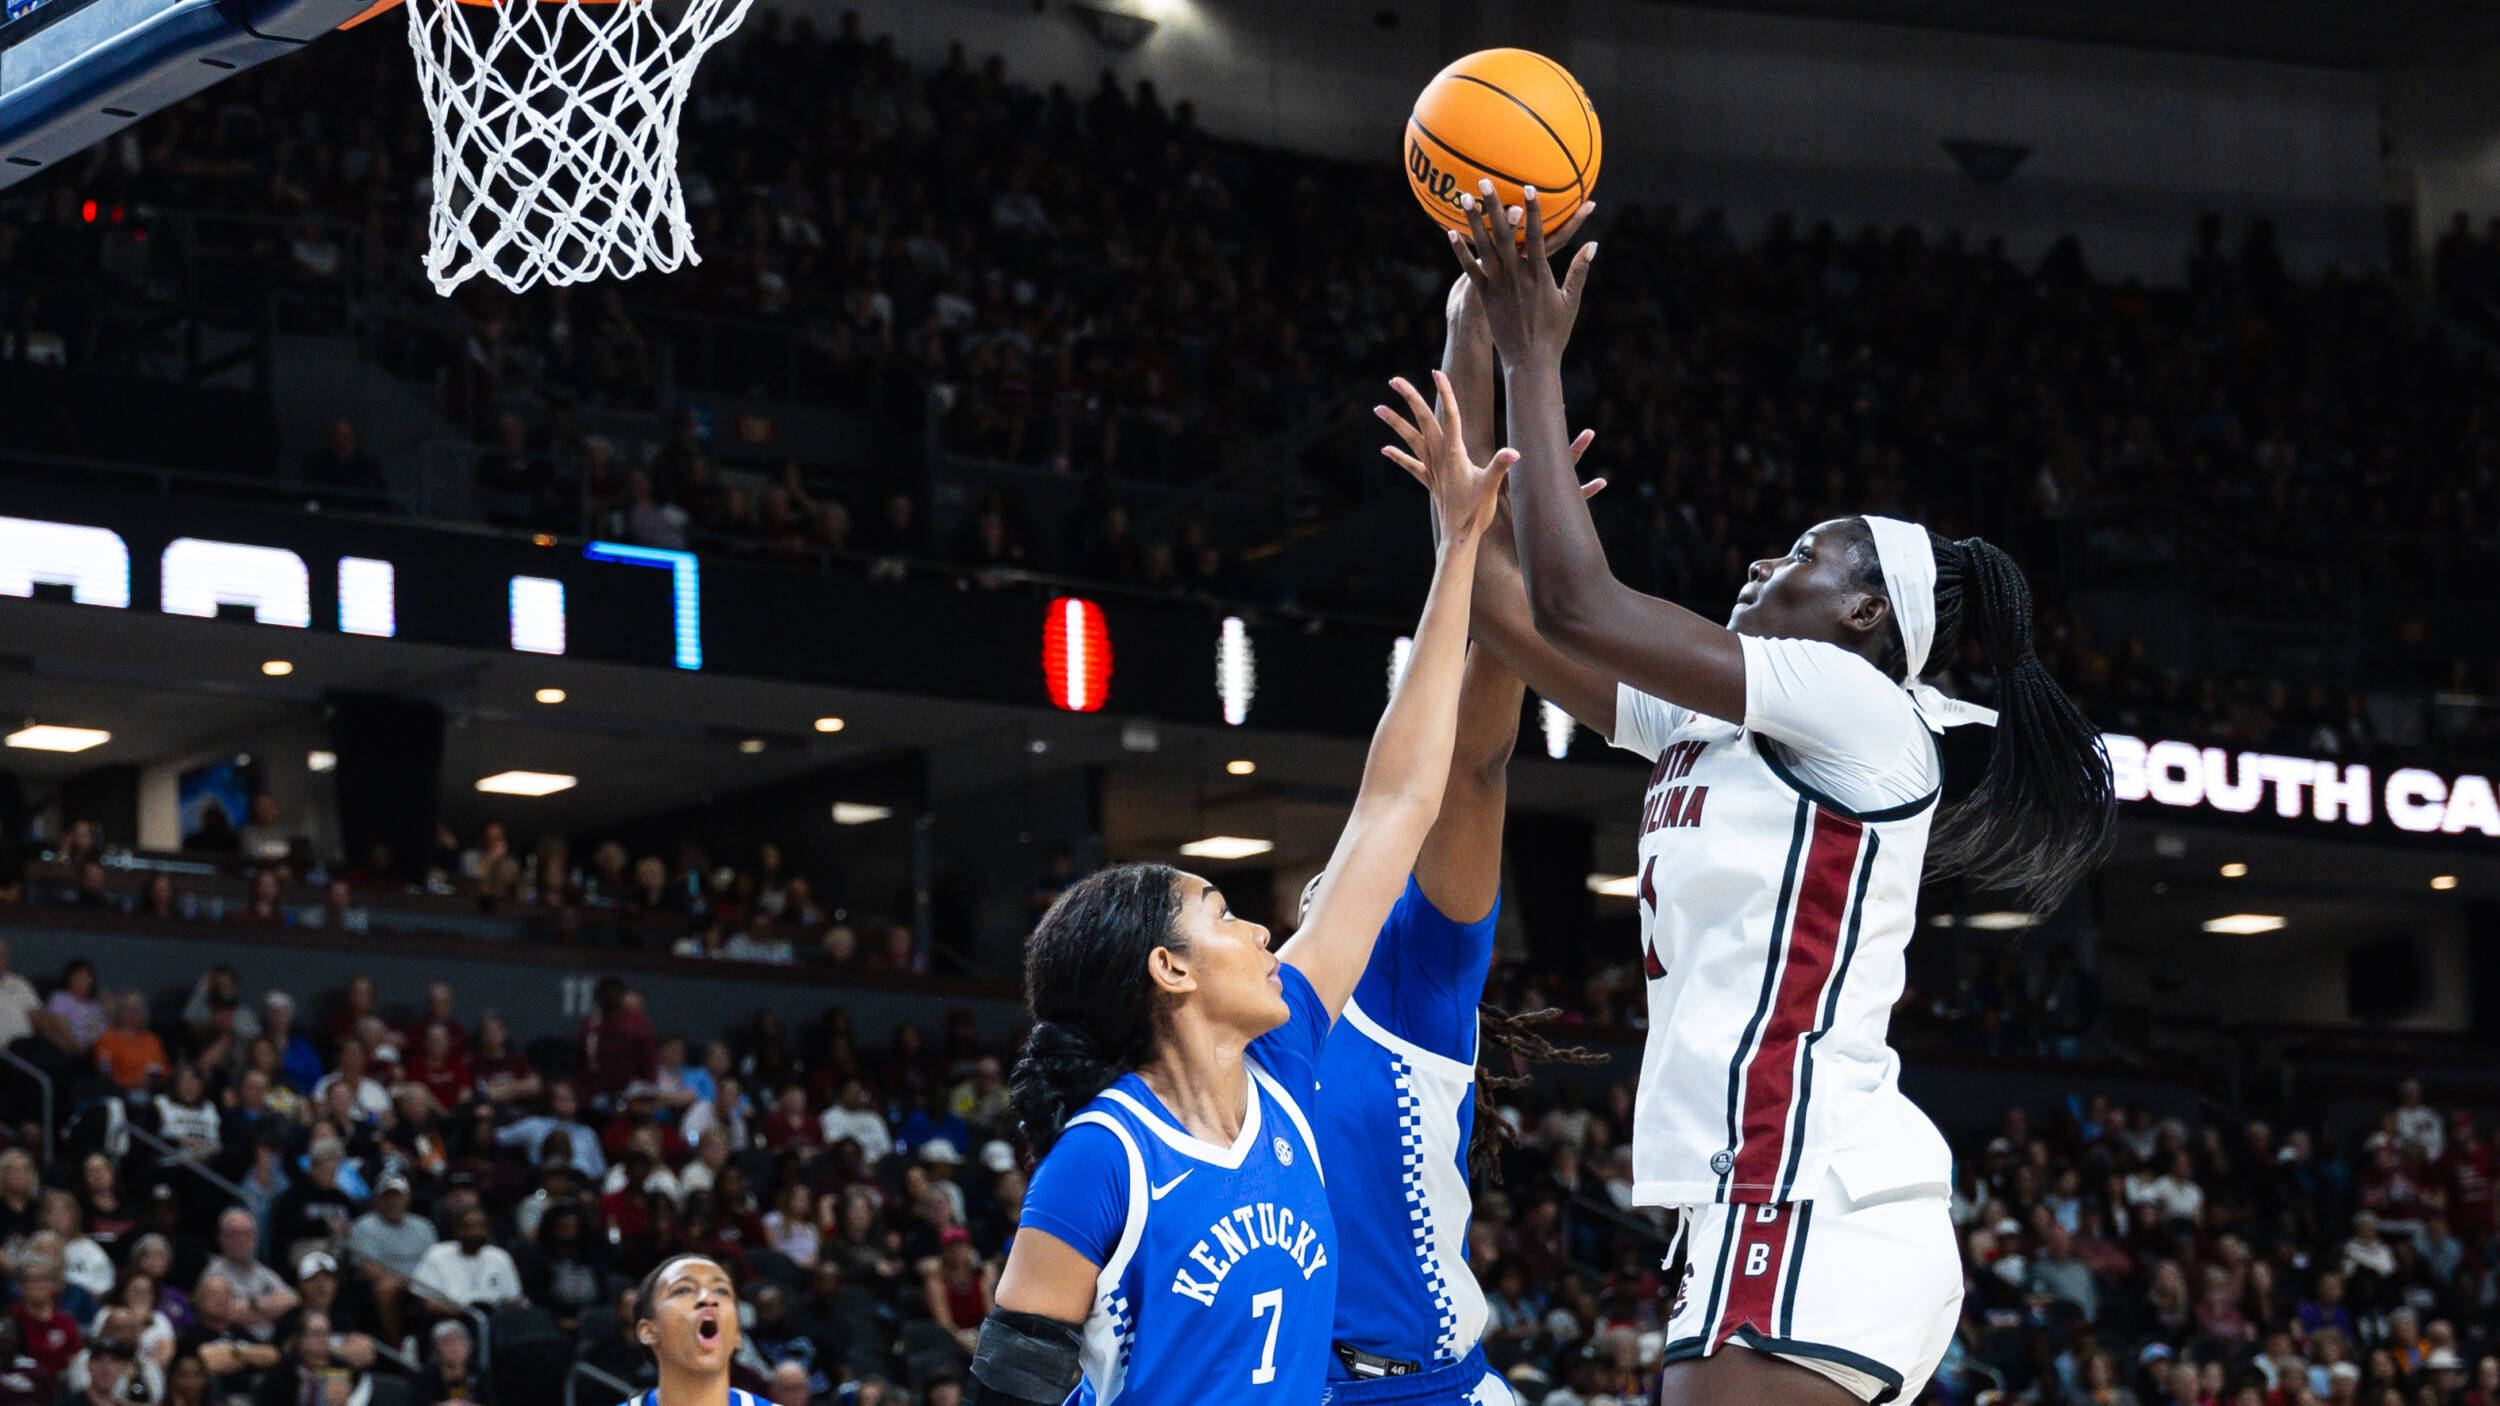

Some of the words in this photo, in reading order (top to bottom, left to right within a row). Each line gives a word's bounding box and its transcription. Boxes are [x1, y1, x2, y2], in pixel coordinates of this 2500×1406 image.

[1409, 136, 1513, 216] Wils
[2100, 733, 2372, 826] SOUTH
[1171, 1202, 1328, 1308] KENTUCKY
[1744, 1243, 1771, 1276] B
[1252, 1287, 1283, 1385] 7
